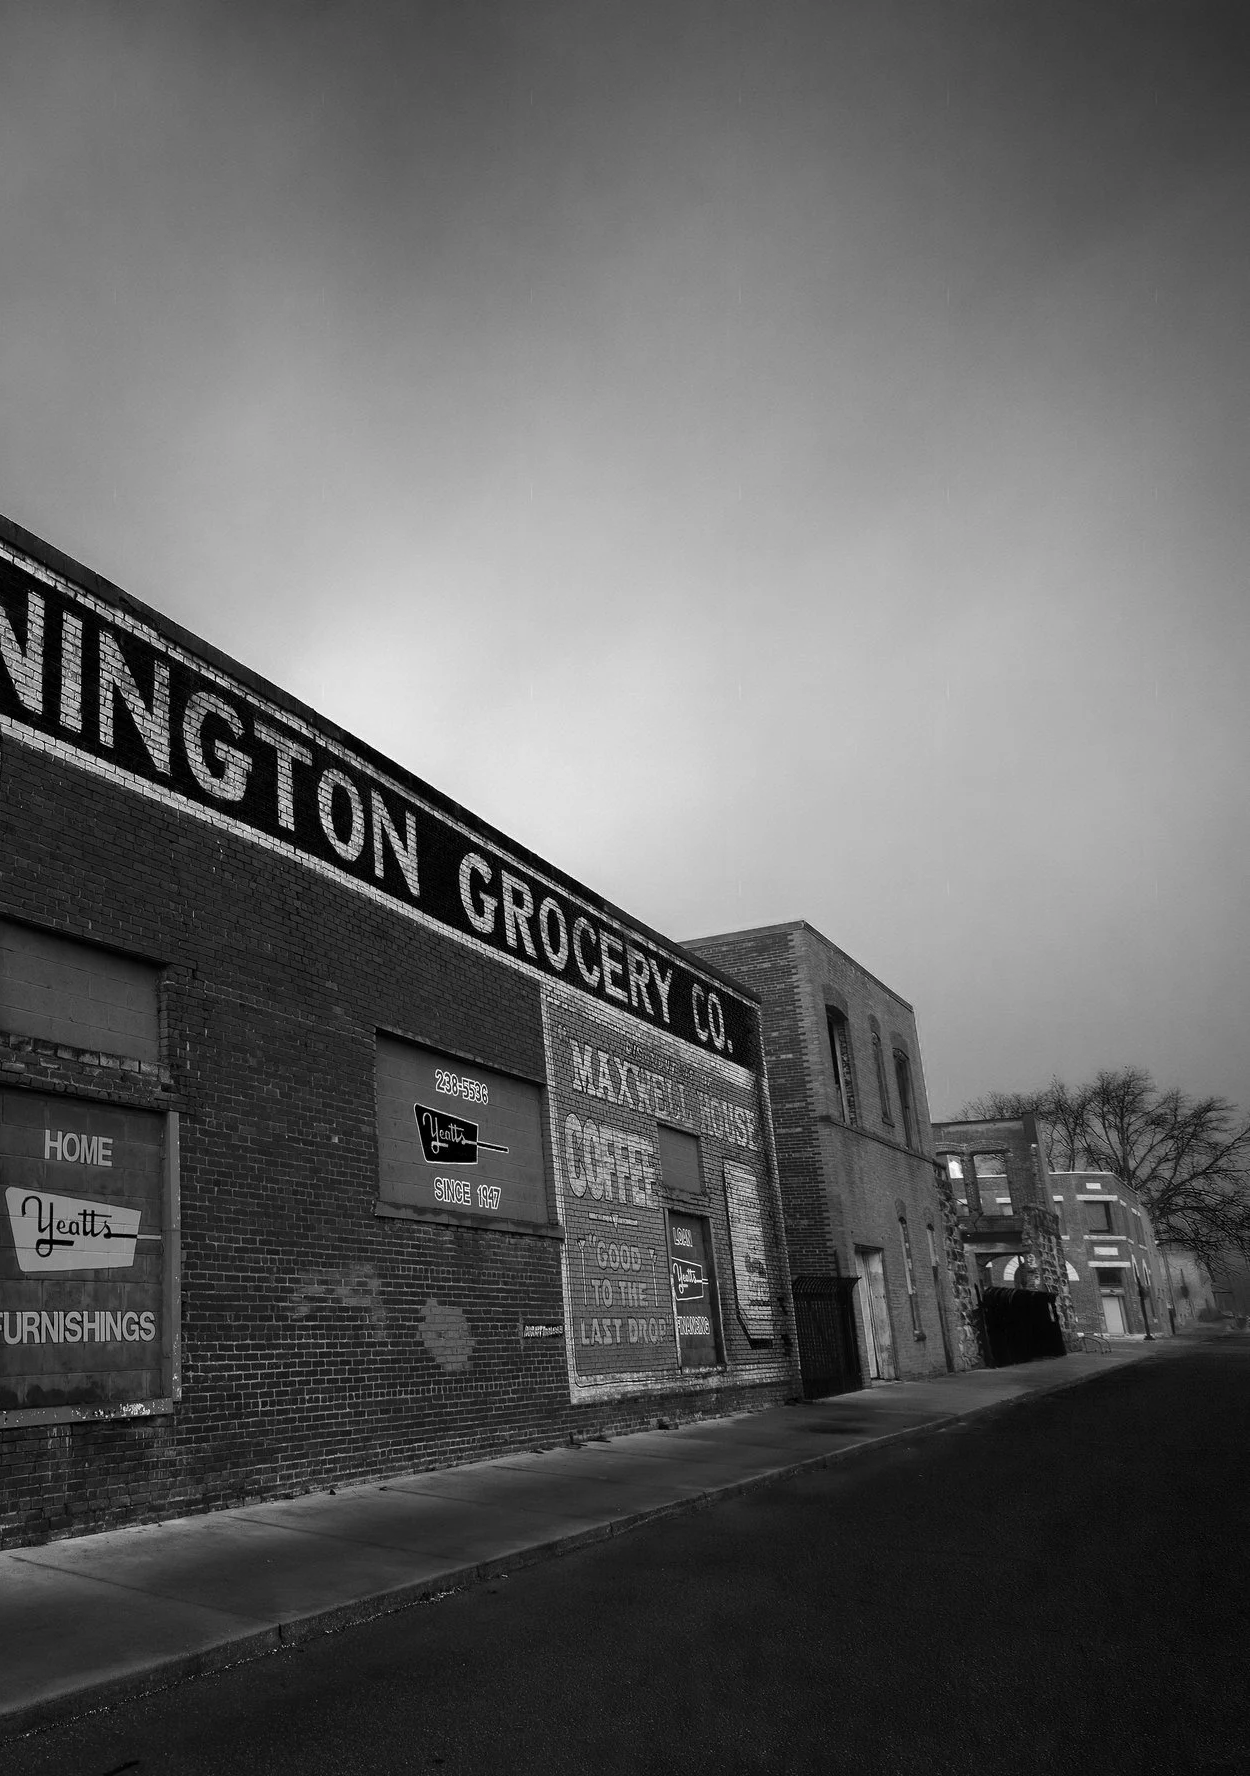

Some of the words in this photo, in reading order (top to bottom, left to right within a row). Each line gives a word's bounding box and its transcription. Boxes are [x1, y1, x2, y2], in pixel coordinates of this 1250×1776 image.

[458, 852, 673, 1024] GROCERY
[691, 983, 733, 1053] CO.
[434, 1068, 489, 1106] 238-5536
[43, 1129, 113, 1168] HOME
[422, 1111, 476, 1154] Yeatts
[564, 1111, 660, 1210] COFFEE
[434, 1176, 471, 1206] SINCE
[477, 1184, 501, 1210] 1947
[21, 1195, 136, 1259] Yeatts
[672, 1227, 693, 1247] LOAN
[591, 1278, 613, 1308] TO
[618, 1280, 649, 1308] THE
[673, 1262, 701, 1294] Yeatts
[580, 1316, 622, 1346] LAST
